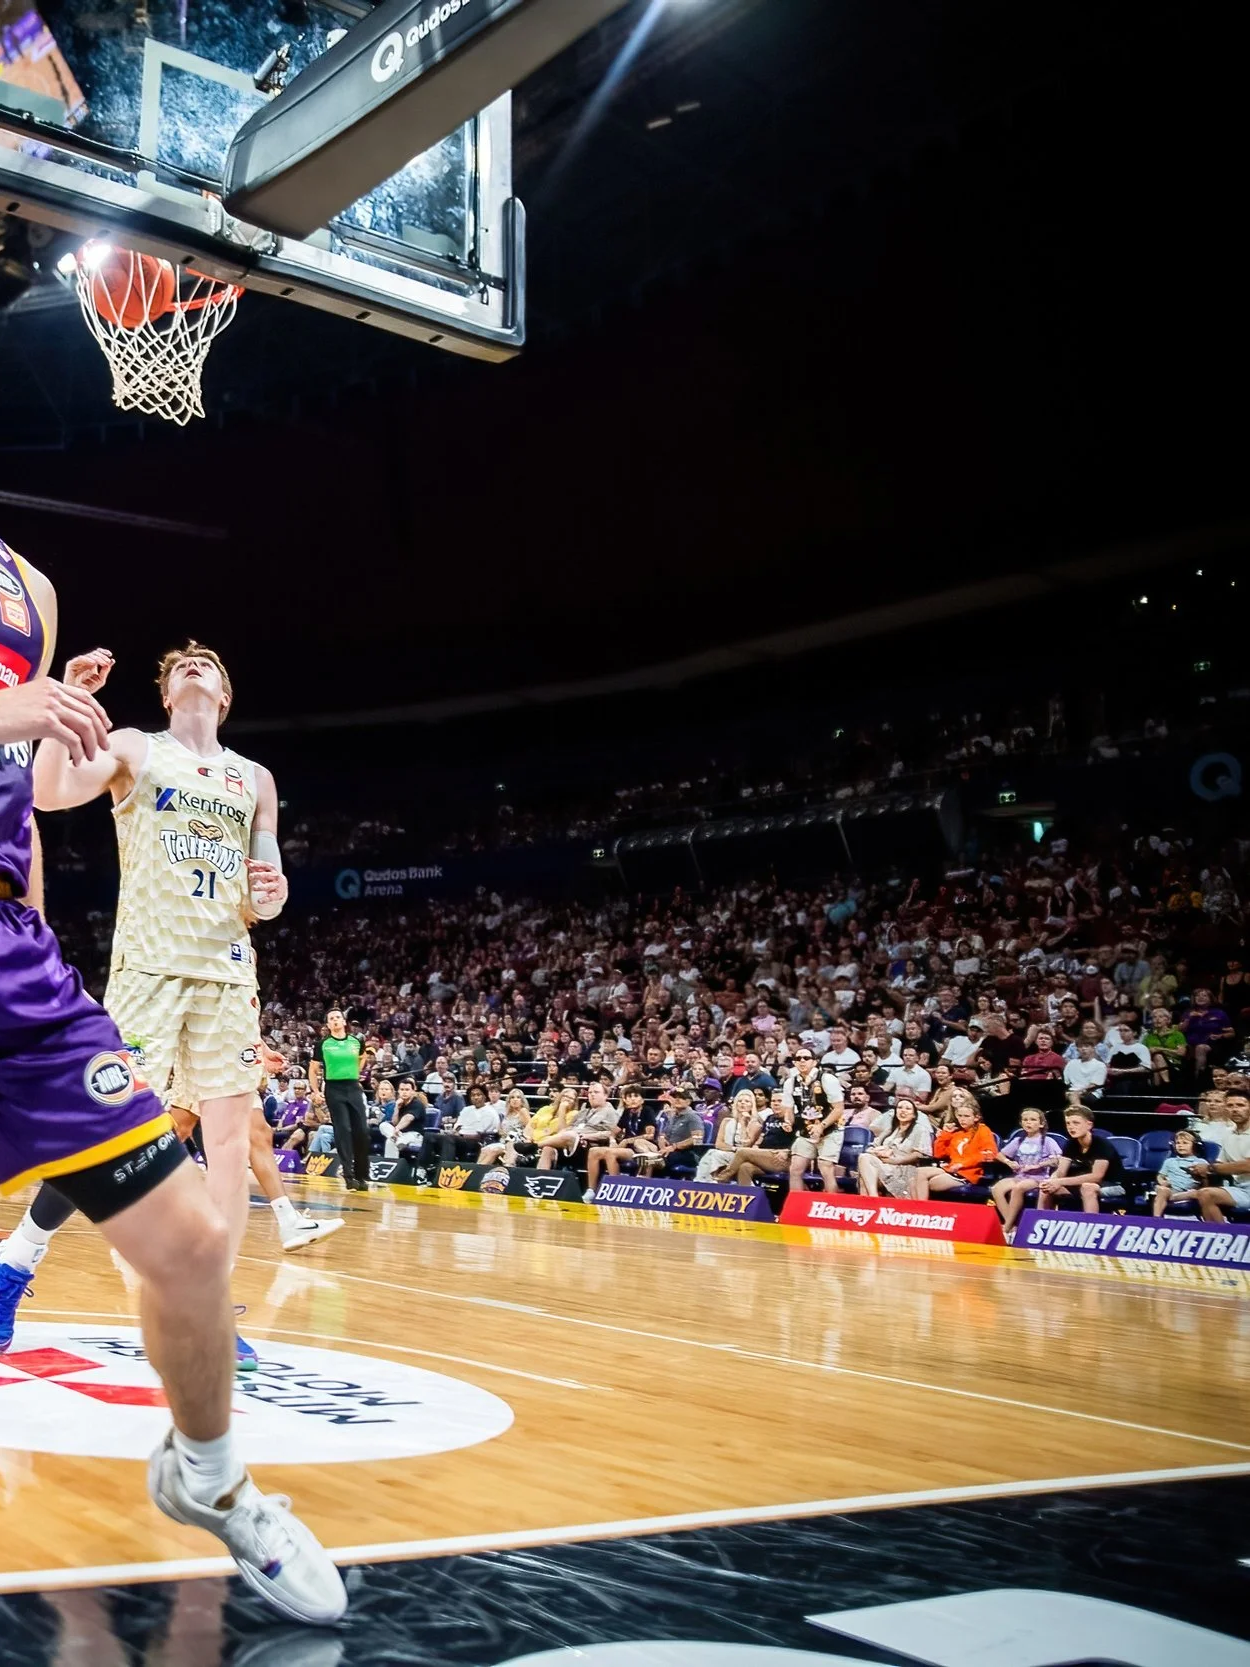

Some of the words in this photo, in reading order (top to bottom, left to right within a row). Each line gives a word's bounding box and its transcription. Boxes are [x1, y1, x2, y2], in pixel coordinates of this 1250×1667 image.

[405, 0, 463, 47] Qudos
[178, 790, 248, 827] Kenfrost
[160, 829, 244, 880] TAIPANS
[191, 868, 216, 900] 21
[363, 868, 407, 882] Qudos
[408, 865, 443, 880] Bank
[364, 883, 404, 896] Arena
[595, 1183, 644, 1203] BUILT
[642, 1186, 674, 1207] FOR
[673, 1189, 756, 1214] SYDNEY
[807, 1201, 876, 1227] Harvey
[879, 1205, 956, 1231] Norman
[1026, 1218, 1122, 1250] SYDNEY
